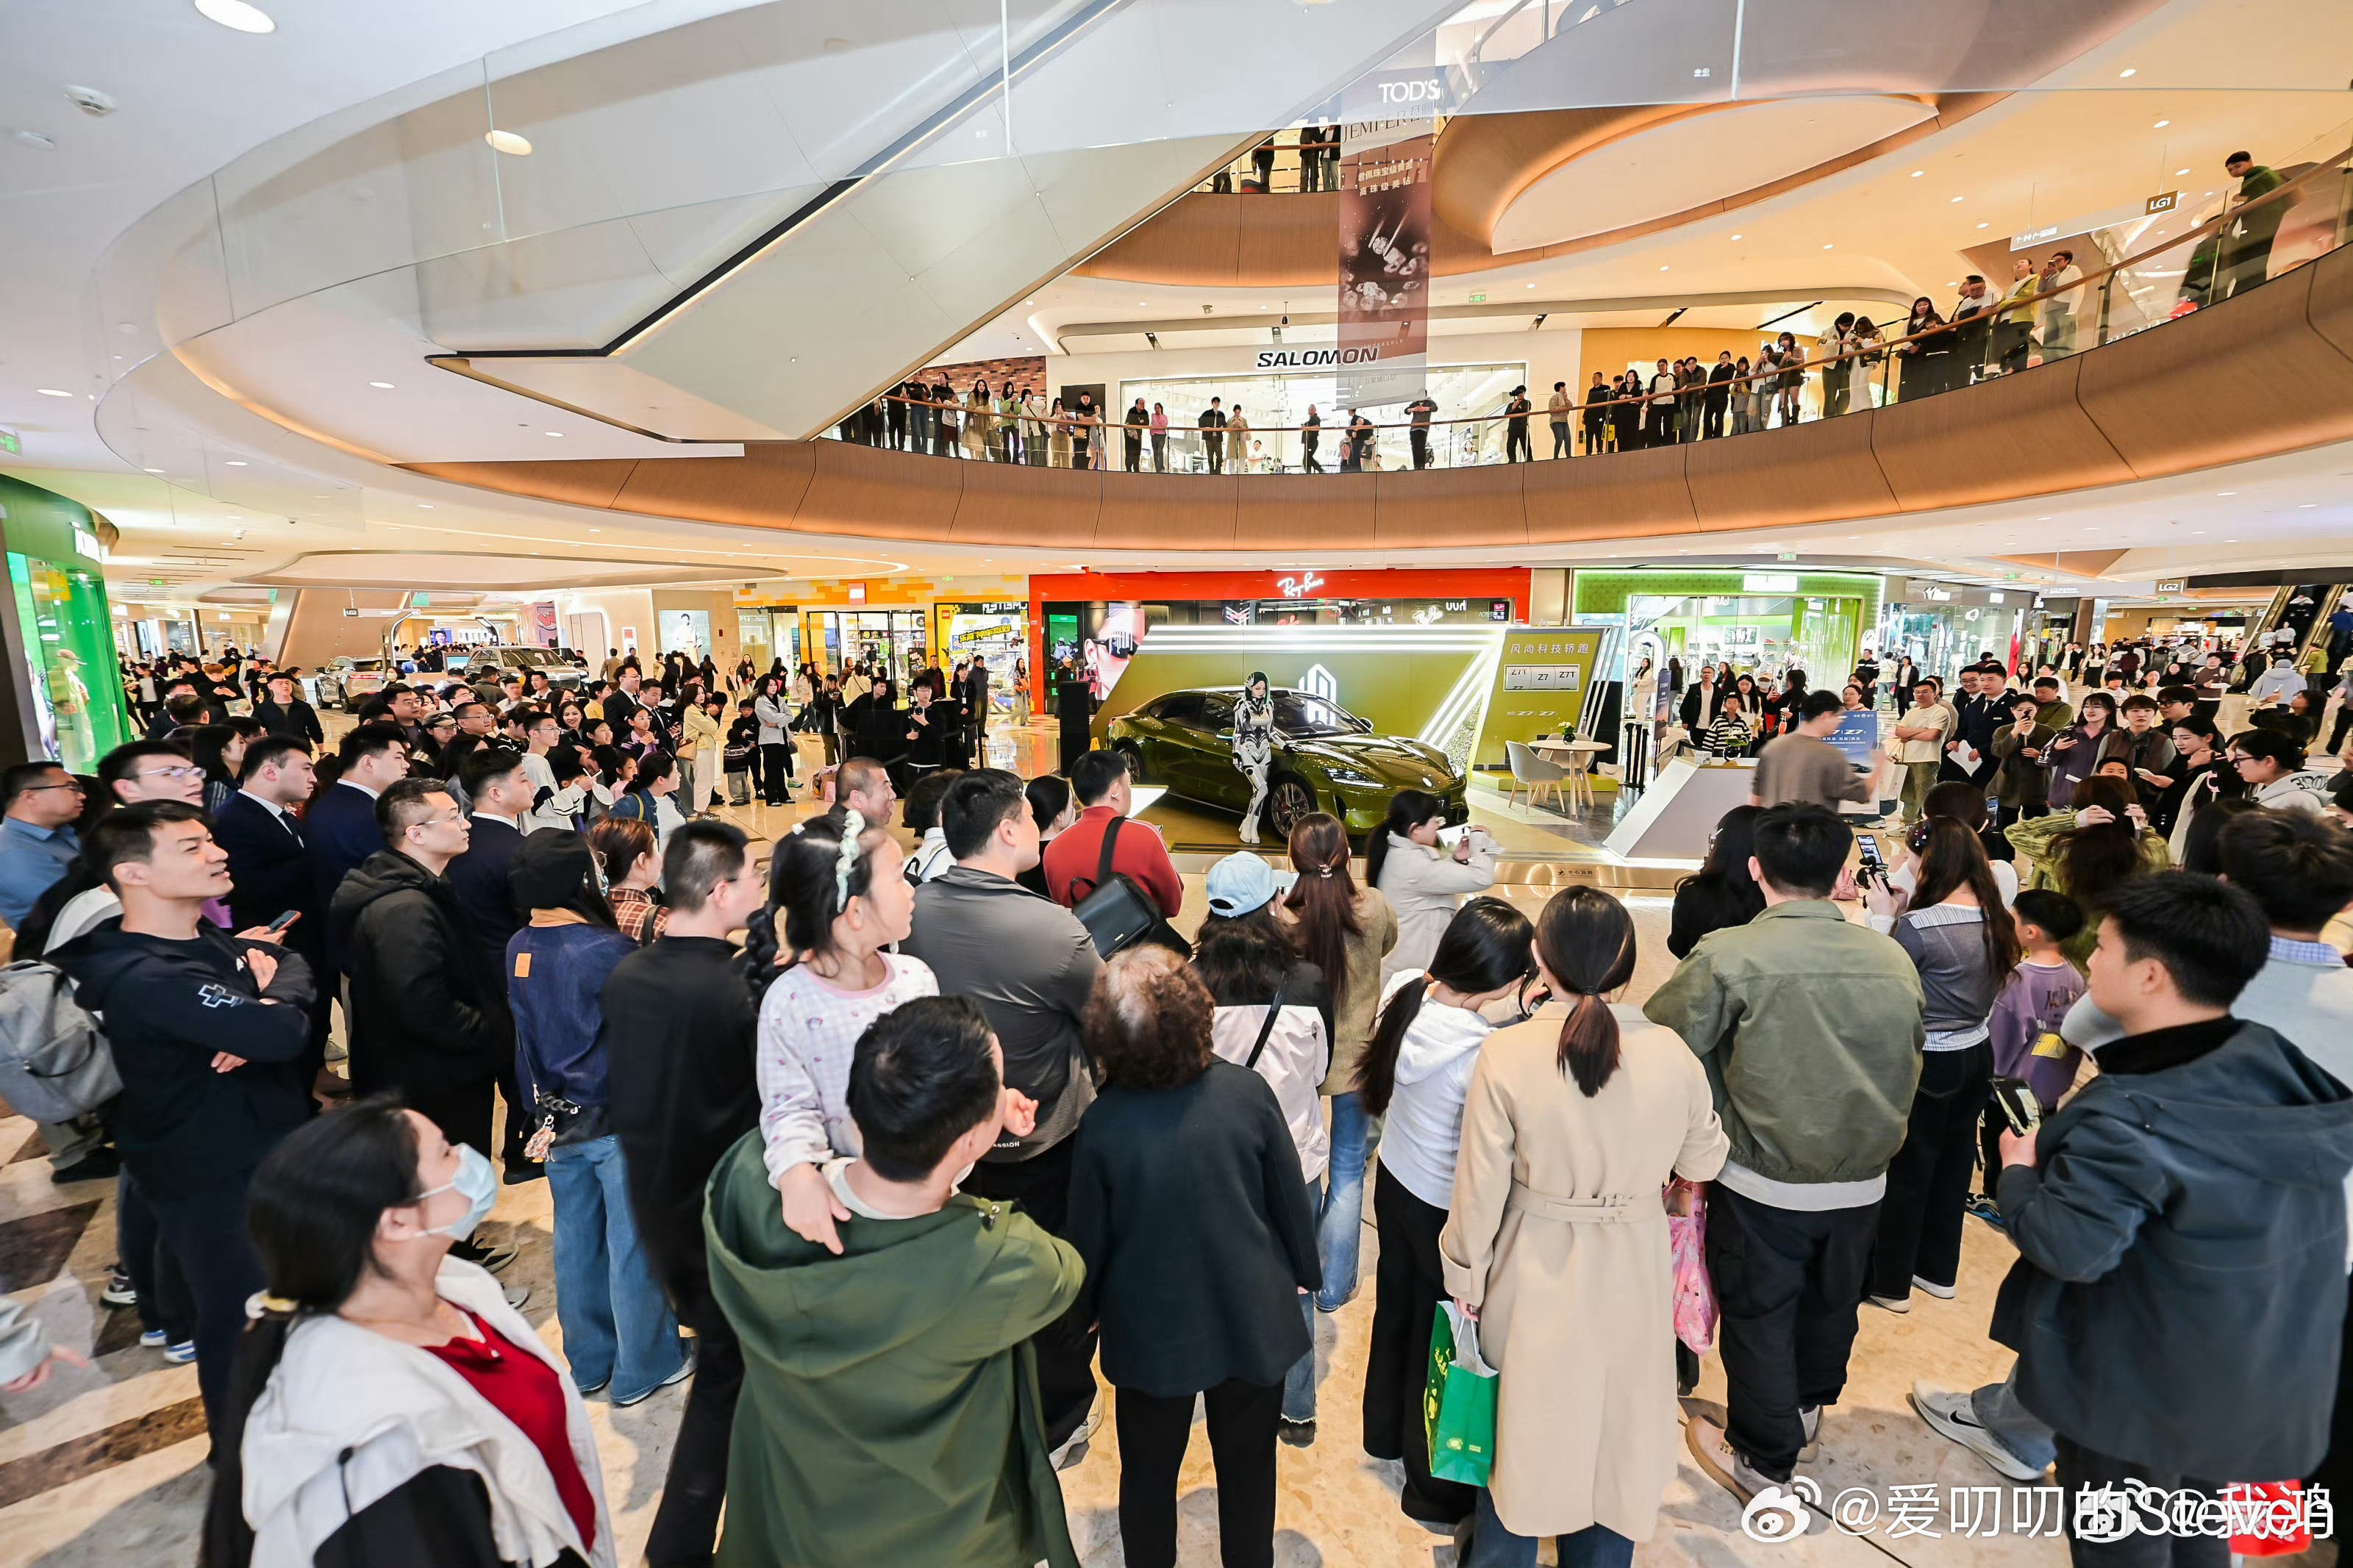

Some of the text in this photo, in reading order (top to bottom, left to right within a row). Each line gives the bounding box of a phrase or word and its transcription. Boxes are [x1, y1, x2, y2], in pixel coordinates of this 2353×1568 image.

[1378, 79, 1439, 104] TOD'S
[1357, 160, 1413, 182] 君佩珠宝级黄金
[2149, 196, 2172, 211] LG1
[1257, 347, 1379, 368] SALOMON
[2158, 584, 2179, 592] LG2
[1510, 644, 1589, 654] 风尚科技轿跑
